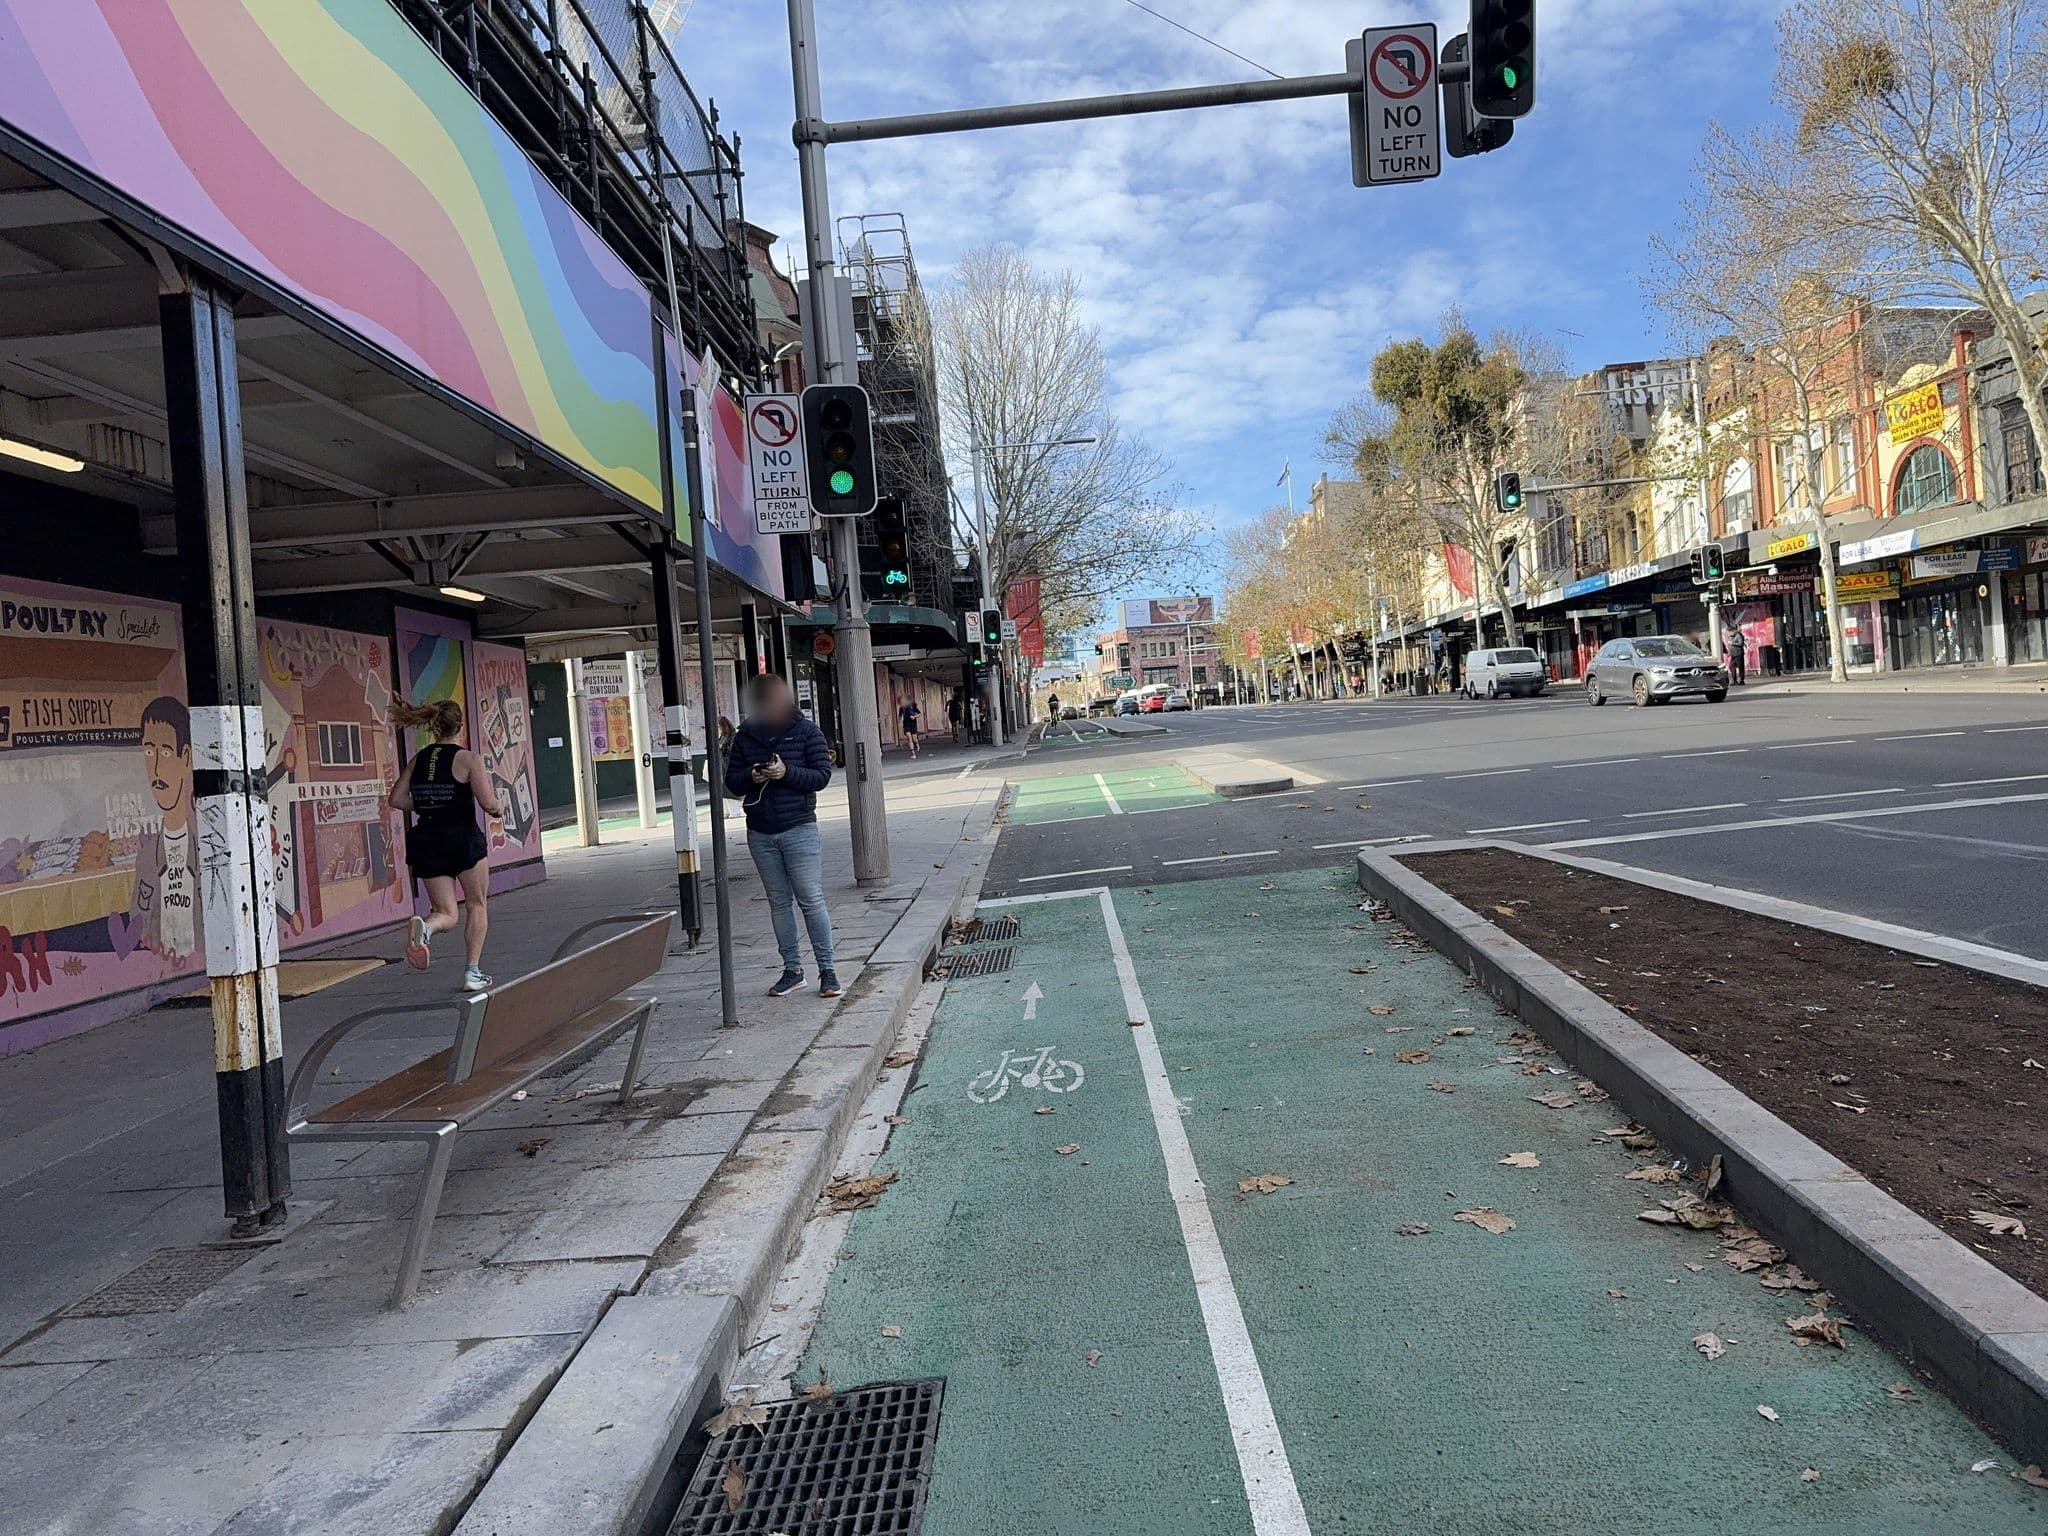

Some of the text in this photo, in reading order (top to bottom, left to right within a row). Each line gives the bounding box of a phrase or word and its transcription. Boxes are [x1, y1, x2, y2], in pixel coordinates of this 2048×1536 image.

[1383, 105, 1422, 130] NO
[1380, 133, 1427, 152] LEFT
[1379, 155, 1430, 174] TURN
[763, 450, 792, 467] NO
[761, 471, 797, 484] LEFT
[761, 487, 800, 498] TURN
[767, 501, 797, 510] FROM
[760, 511, 807, 521] BICYCLE
[769, 520, 799, 530] PATH
[1924, 552, 1968, 563] FOR LEASE
[1759, 580, 1811, 593] Massage
[1, 600, 108, 638] POULTRY
[22, 698, 63, 728] FISH
[68, 697, 114, 726] SUPPLY
[15, 734, 57, 745] POULTRY
[67, 732, 105, 743] OYSTERS
[298, 783, 354, 799] RINKS
[167, 865, 185, 881] GAY
[168, 881, 183, 891] AND
[163, 891, 191, 910] PROUD
